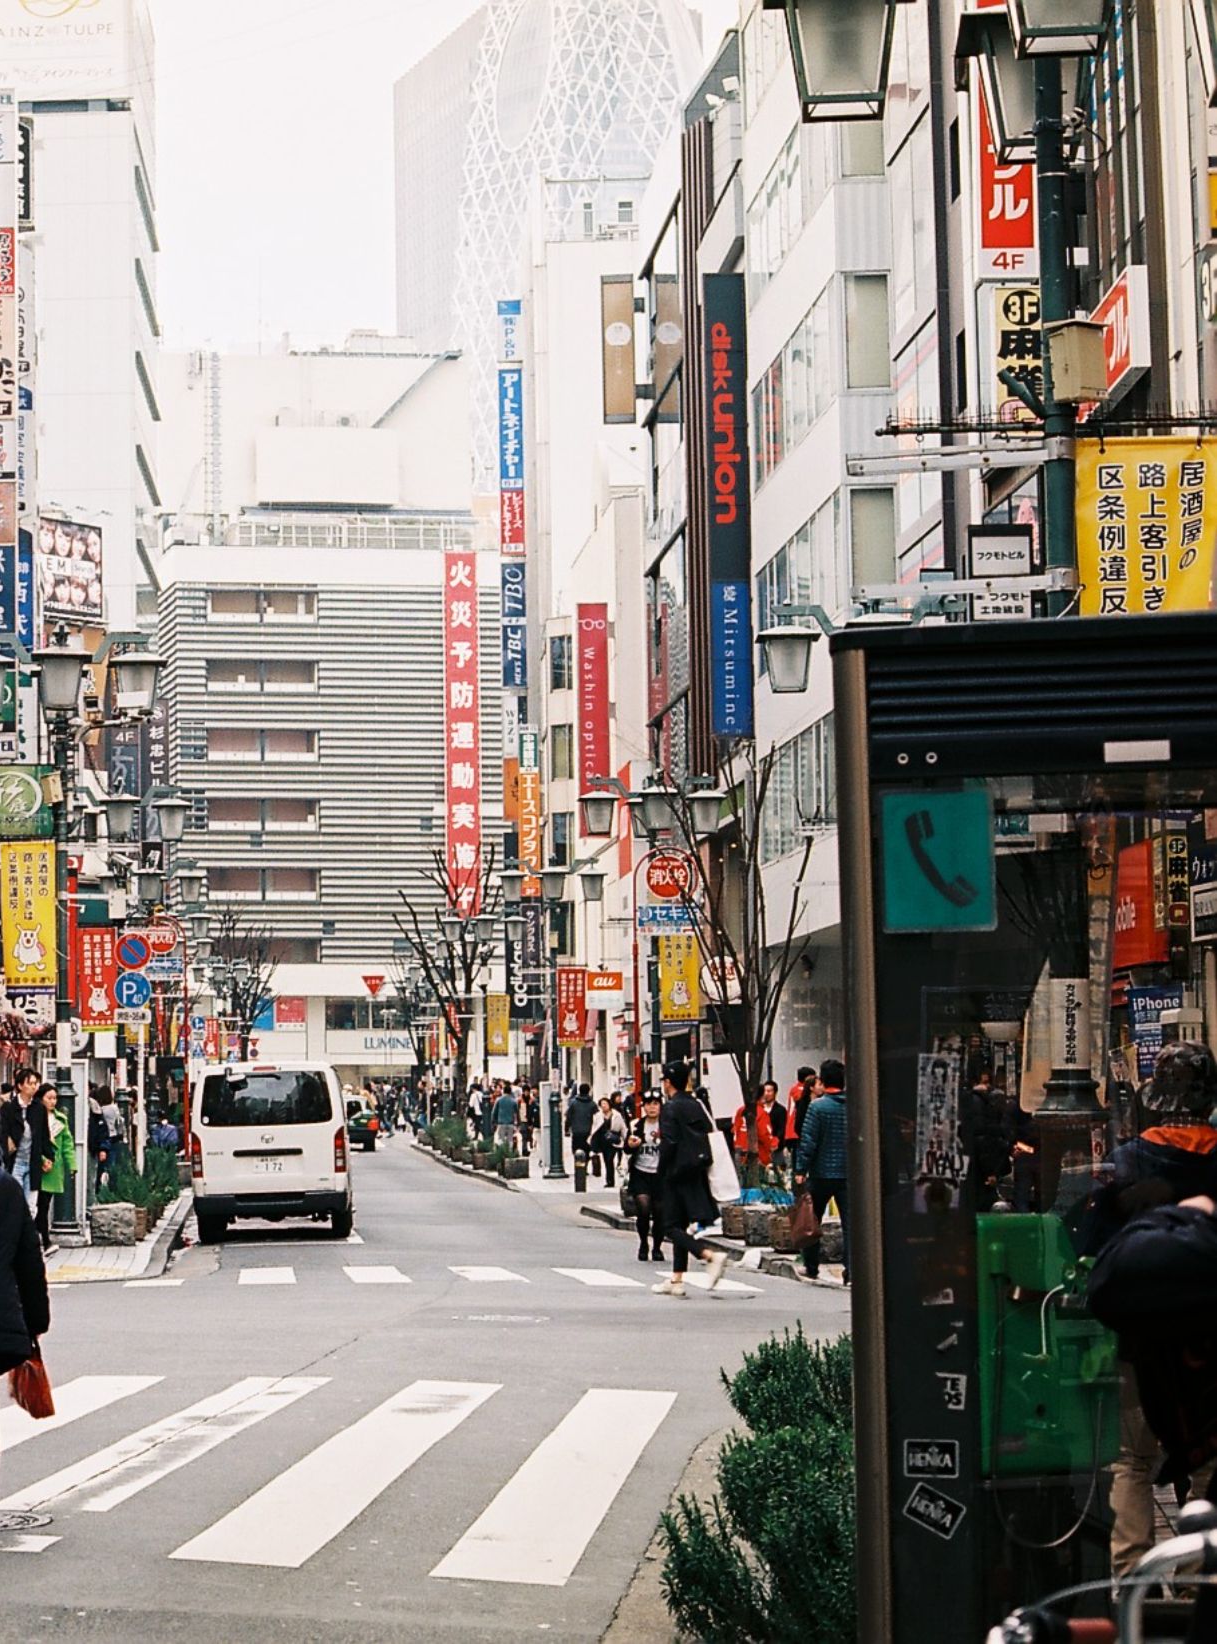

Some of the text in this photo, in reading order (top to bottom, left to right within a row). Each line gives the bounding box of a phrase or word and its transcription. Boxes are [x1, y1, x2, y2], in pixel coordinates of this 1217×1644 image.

[63, 22, 113, 35] TULPE
[992, 252, 1024, 270] 4F
[1006, 295, 1040, 322] 3F
[711, 322, 732, 391] disk
[501, 373, 521, 477] アートネイチャー
[713, 394, 739, 524] union
[1178, 461, 1205, 570] 居酒屋の
[976, 551, 1025, 561] フクモトビル
[505, 567, 523, 611] TBC
[507, 629, 521, 659] TBC
[583, 647, 597, 787] Washin optica
[115, 731, 134, 742] 4F
[649, 868, 686, 886] 消火栓
[123, 981, 137, 1004] P
[593, 977, 617, 987] au
[1133, 997, 1179, 1011] iPhone
[364, 1036, 412, 1050] LUMINE
